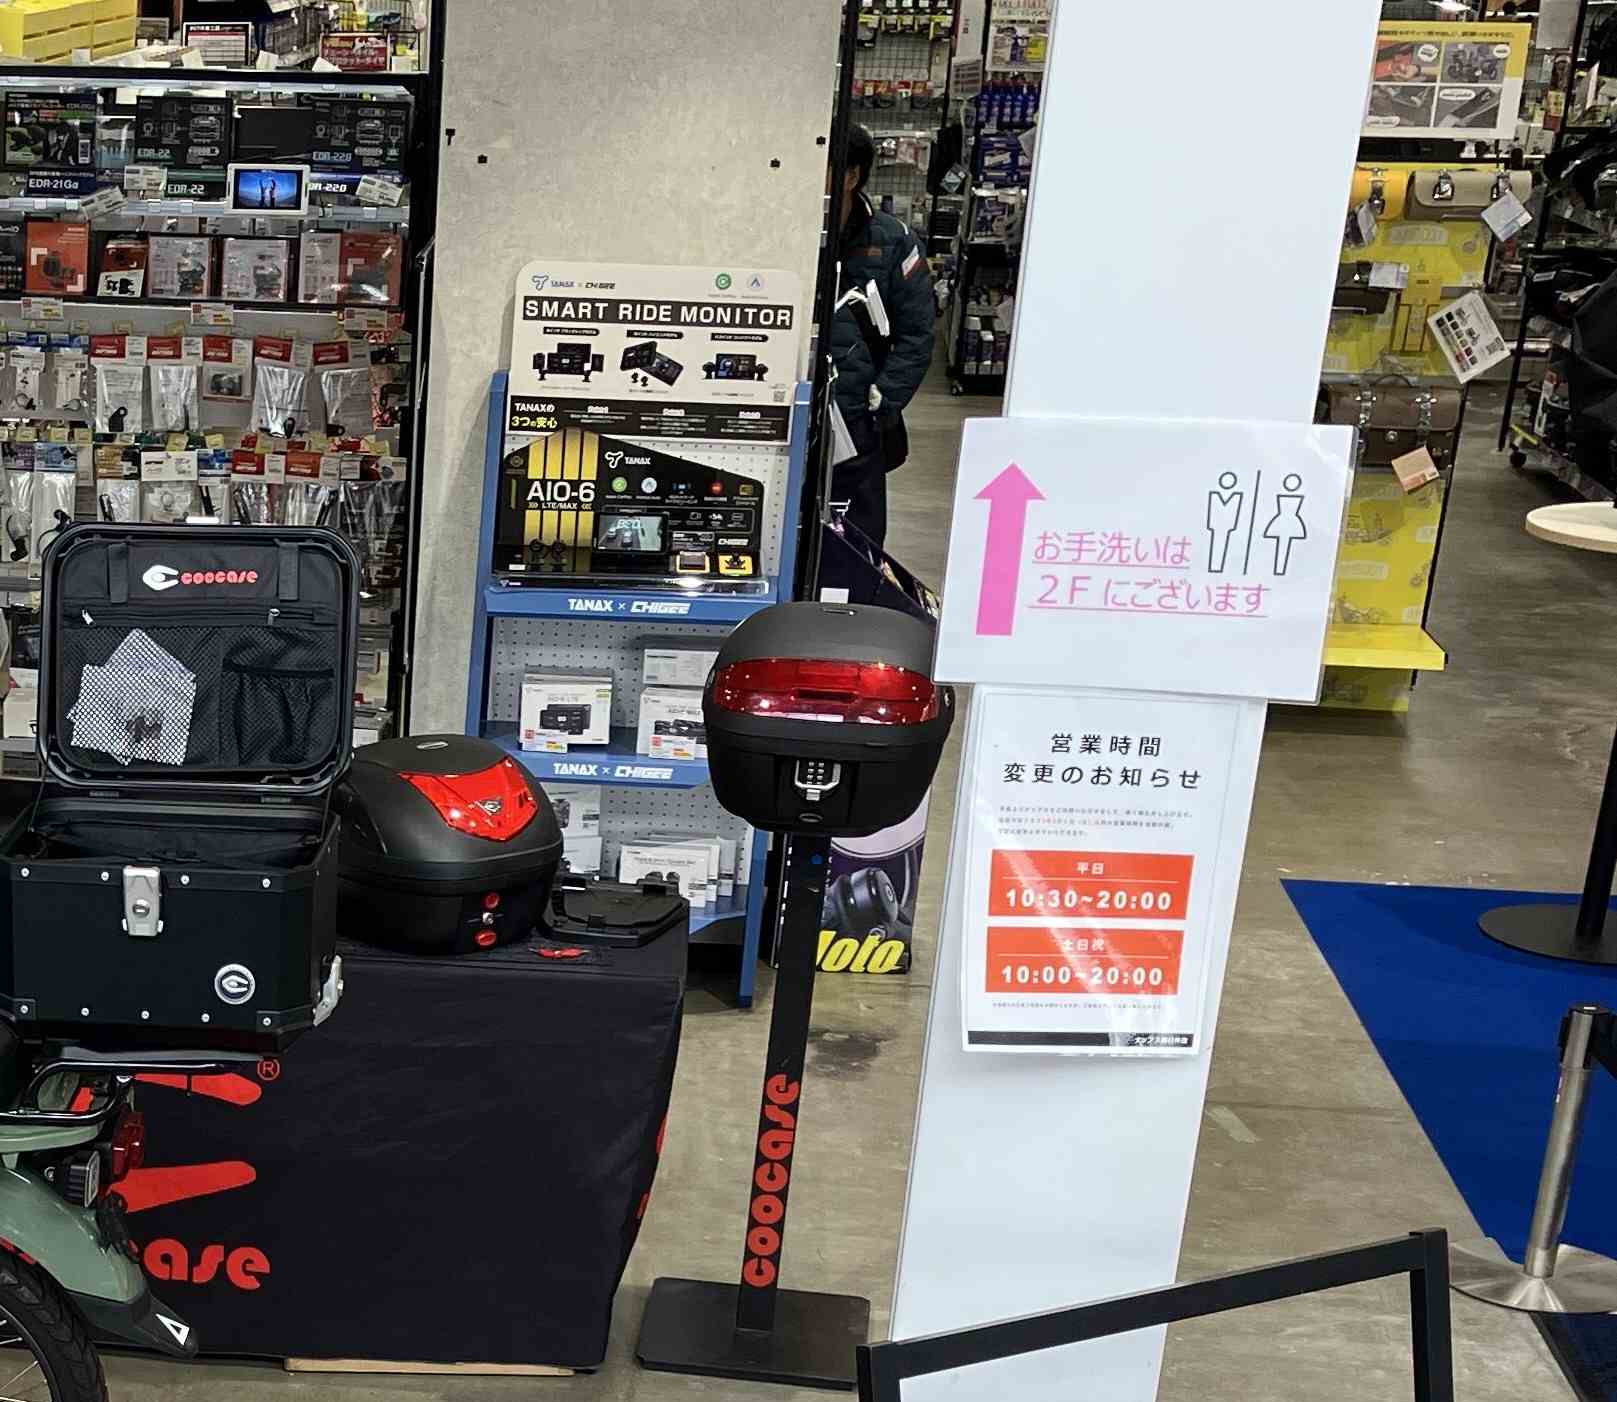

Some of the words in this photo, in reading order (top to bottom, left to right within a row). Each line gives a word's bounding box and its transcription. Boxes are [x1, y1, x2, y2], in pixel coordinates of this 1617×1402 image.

[524, 299, 609, 320] SMART
[618, 303, 673, 323] RIDE
[680, 305, 792, 327] MONITOR
[526, 480, 596, 503] AIO-6
[1033, 530, 1192, 565] お手洗いは
[181, 569, 259, 585] coocase
[567, 598, 613, 613] TANAX
[630, 600, 692, 615] CHIGEE
[1050, 732, 1162, 758] 営業時間
[553, 762, 598, 777] TANAX
[614, 765, 674, 780] CHIGEE
[1002, 762, 1203, 790] 変更のお知らせ
[1075, 861, 1106, 876] 平日
[1060, 938, 1106, 953] 土日祝
[742, 1073, 802, 1288] coocase
[129, 1237, 271, 1290] ase
